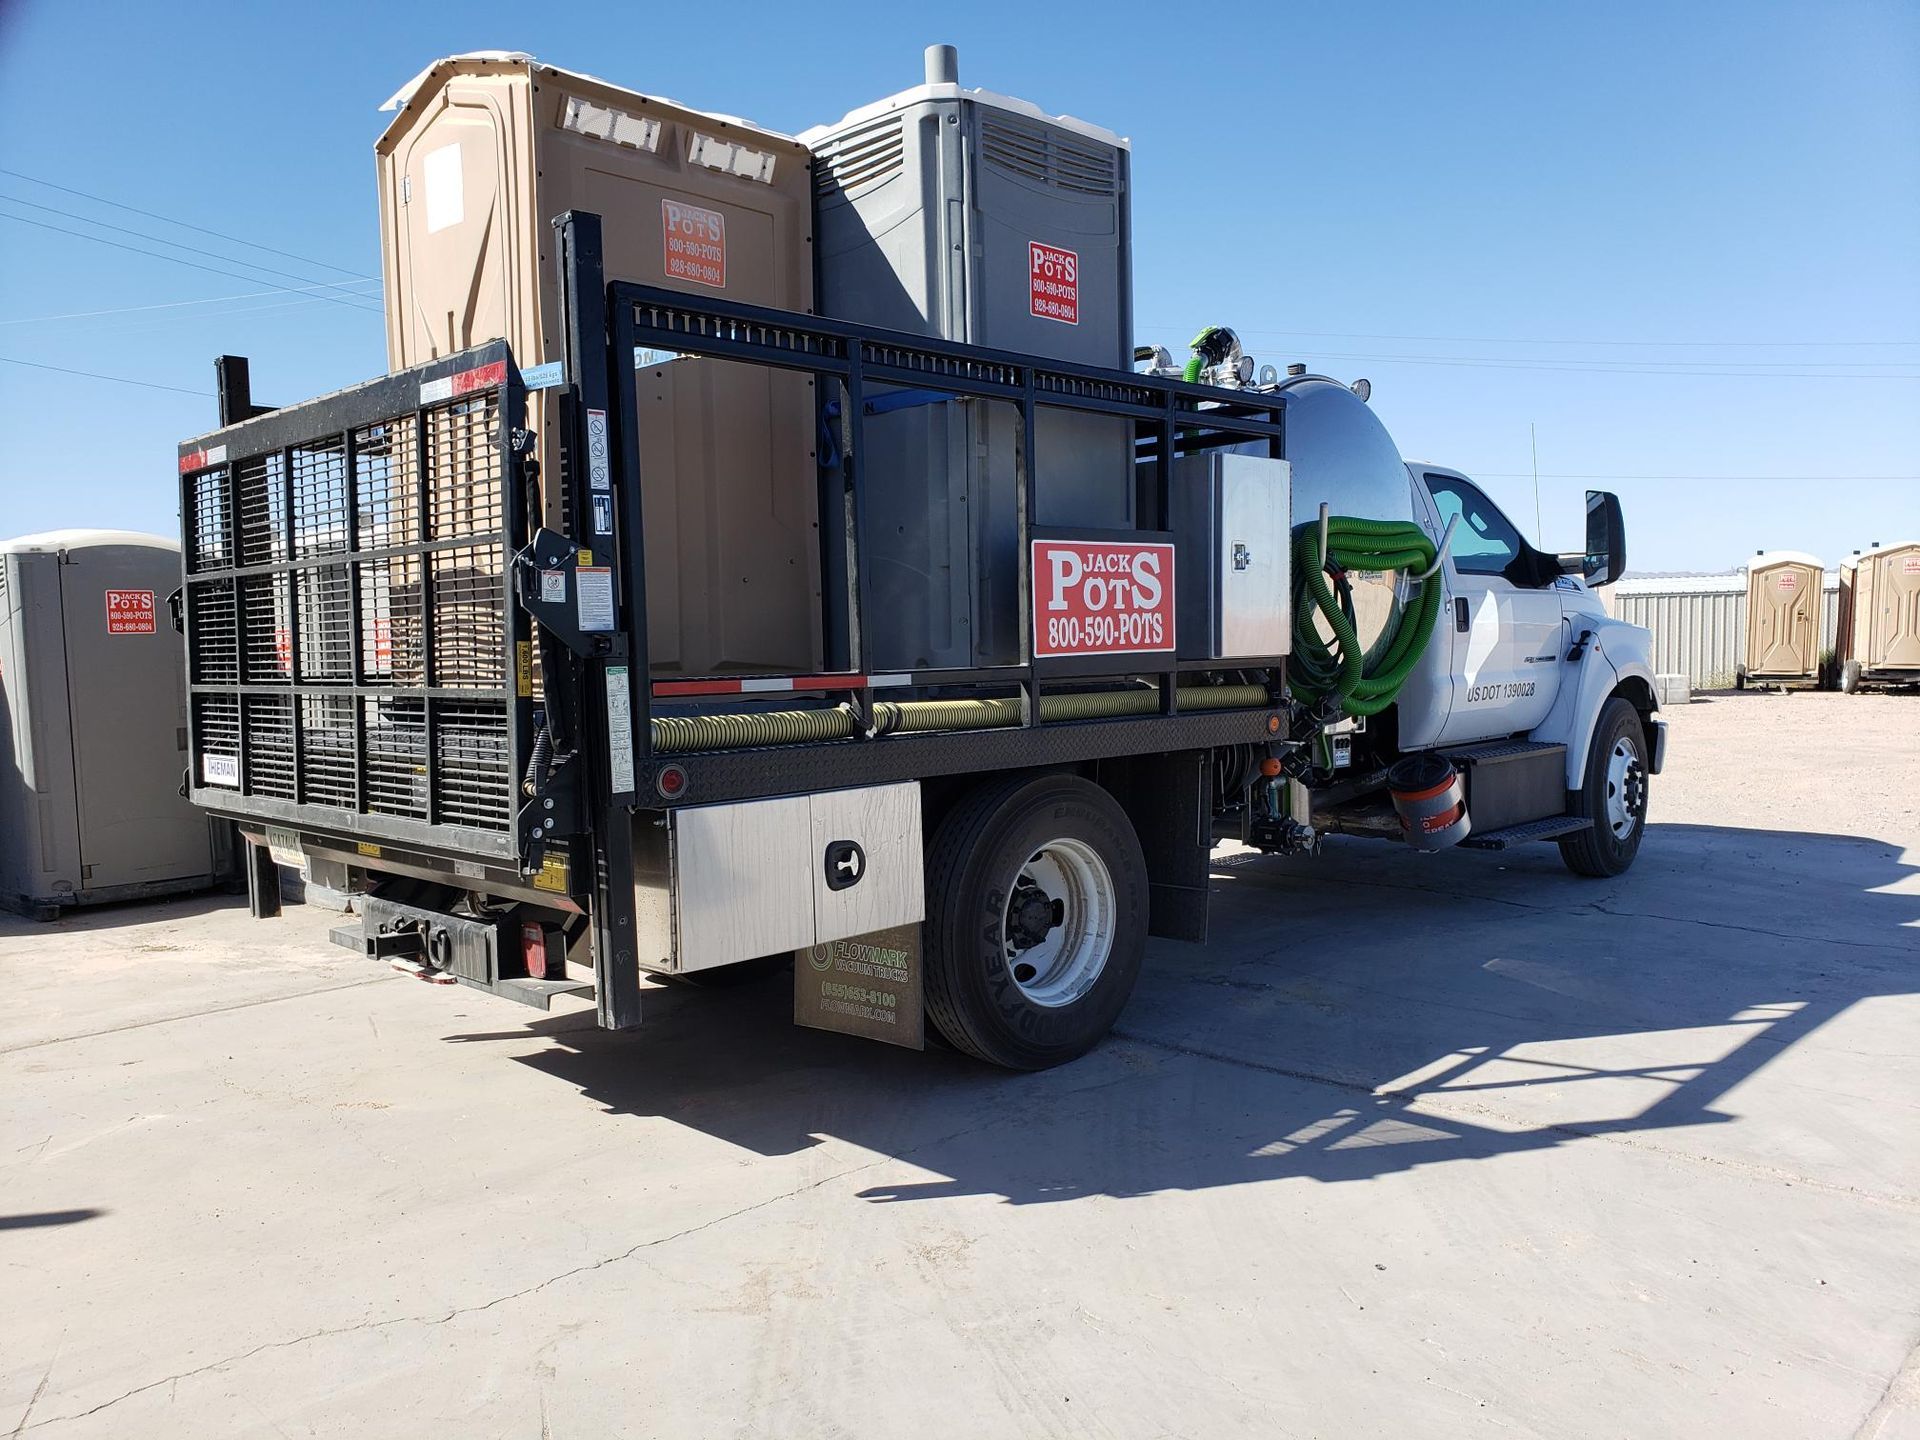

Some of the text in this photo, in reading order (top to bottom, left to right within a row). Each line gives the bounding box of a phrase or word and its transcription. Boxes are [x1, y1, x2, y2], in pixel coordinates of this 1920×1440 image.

[666, 204, 721, 241] POTS
[668, 237, 721, 262] 800-590-POTS
[1044, 251, 1065, 265] JACK
[1032, 248, 1075, 282] POTS
[1083, 553, 1132, 573] JACK
[1047, 550, 1162, 611] POTS
[109, 593, 152, 609] POTS
[1048, 612, 1163, 648] 800-590-POTS
[1467, 682, 1536, 702] US DOT 1390028
[834, 941, 908, 969] FLOWMARK
[835, 959, 909, 983] VACUUM TRUCKS
[820, 998, 896, 1024] FLOWMARK.COM
